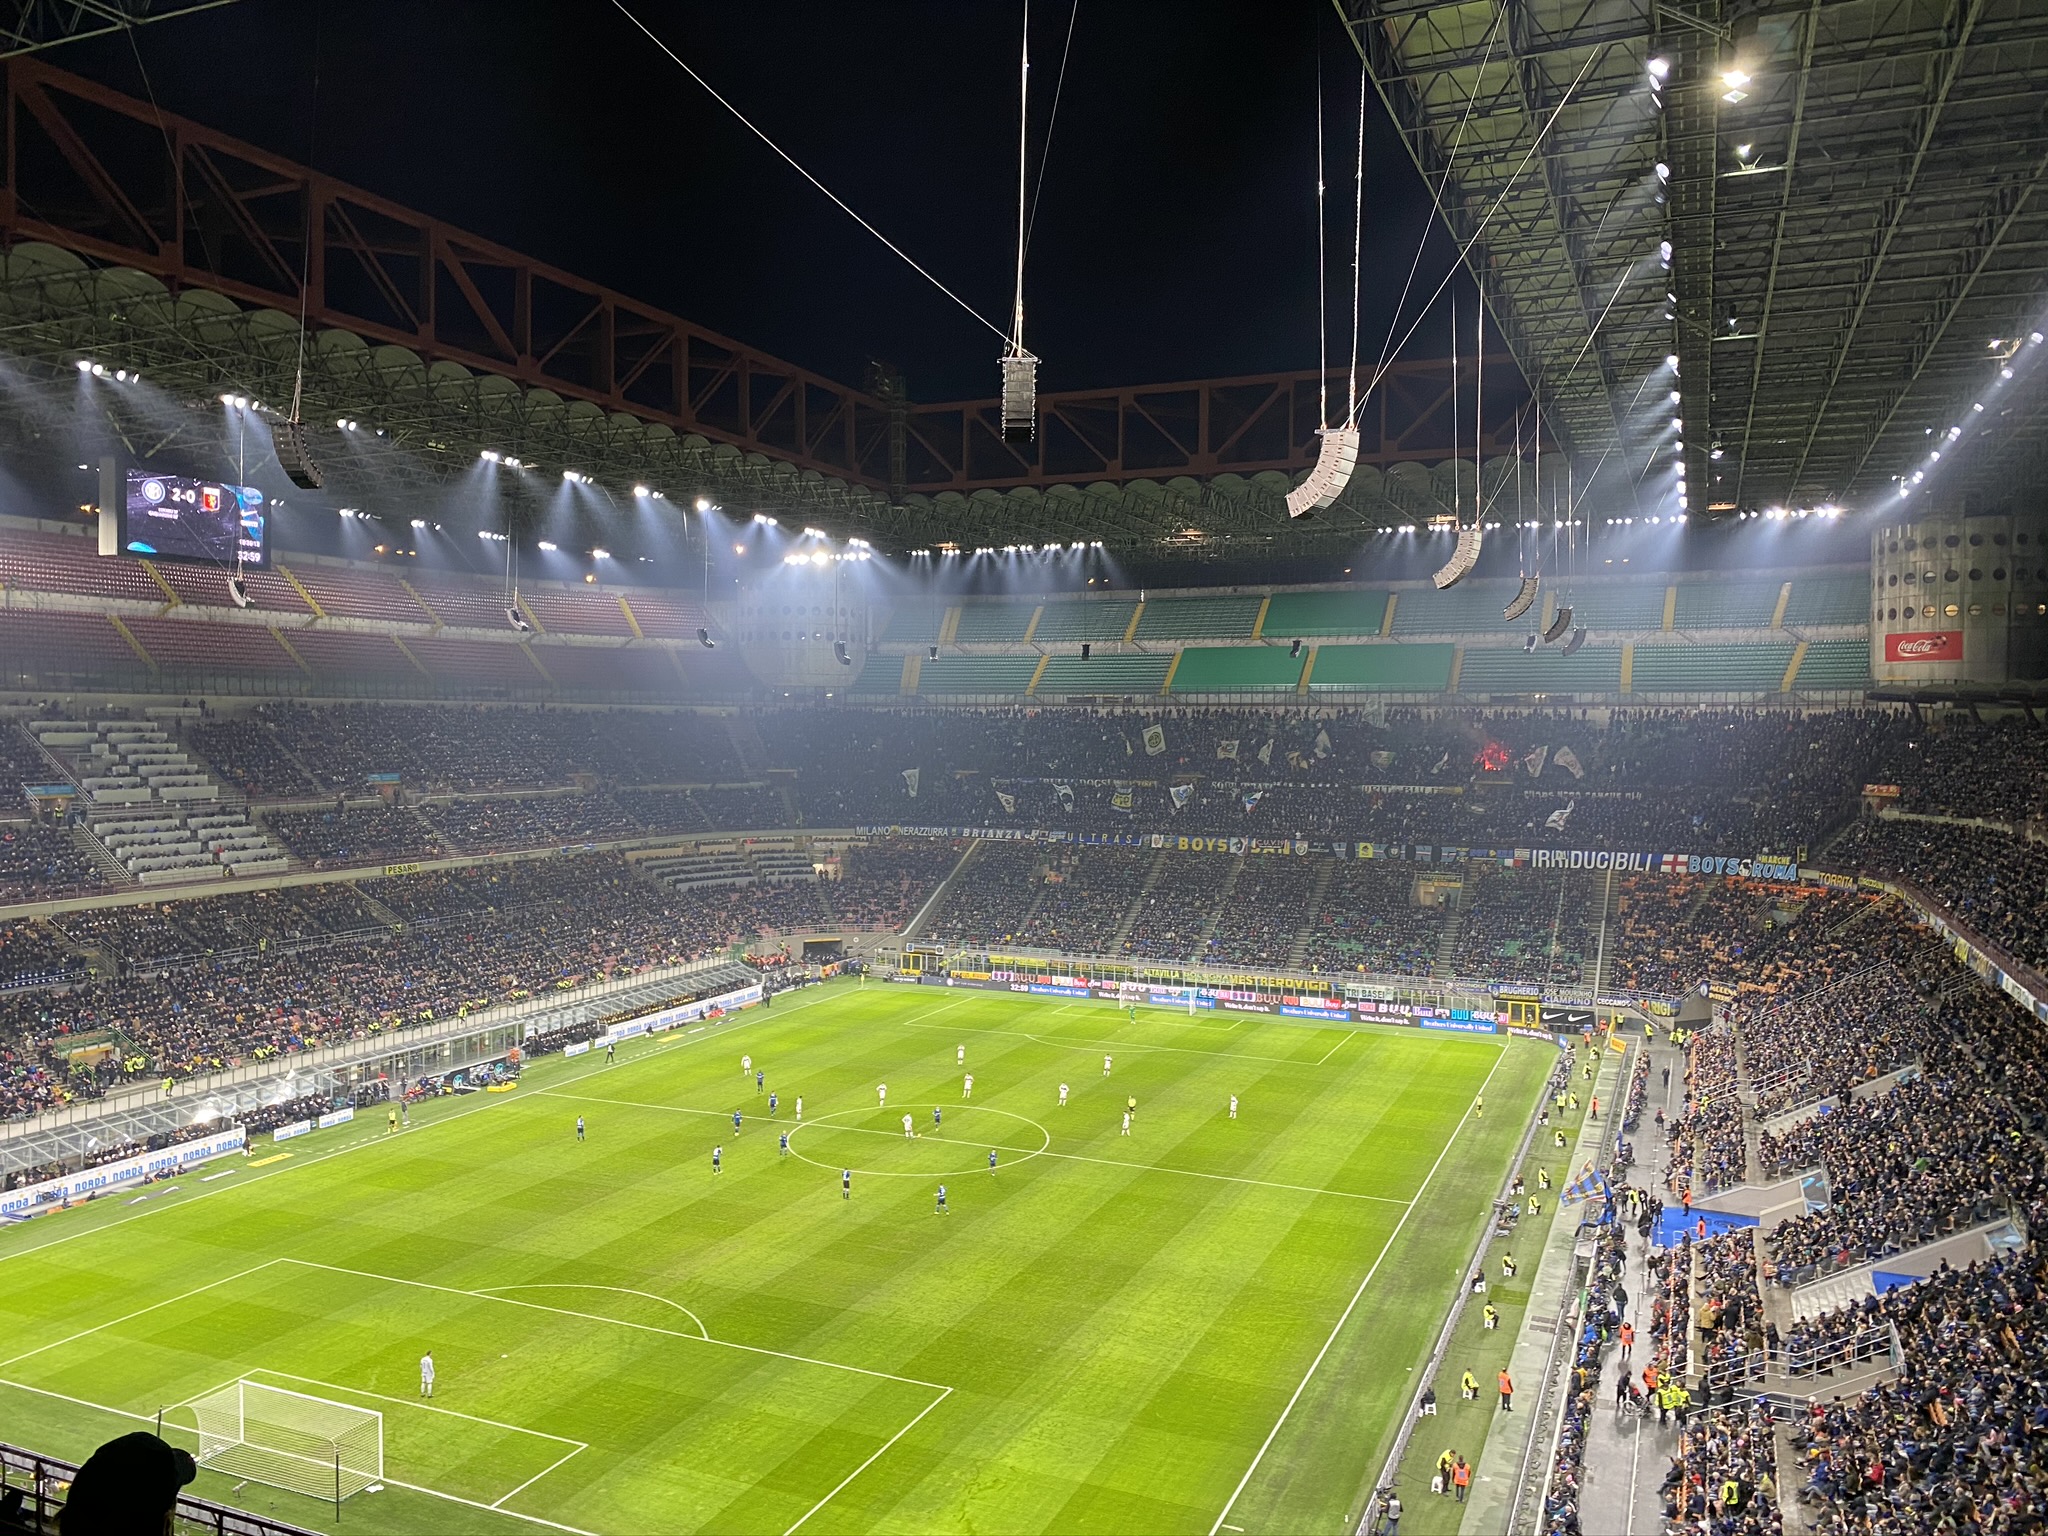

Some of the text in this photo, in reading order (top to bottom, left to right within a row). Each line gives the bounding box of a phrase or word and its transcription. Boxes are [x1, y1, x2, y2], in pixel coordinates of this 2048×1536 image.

[171, 488, 195, 503] 2-0
[856, 826, 948, 836] MILANO NERAZZURRA
[962, 828, 1021, 839] BRIANZA
[1067, 832, 1132, 844] ULTRAS
[1178, 837, 1228, 852] BOYS
[387, 863, 418, 874] PESARO
[1688, 855, 1797, 881] BOYS ROMA
[1819, 872, 1853, 889] TORRITA
[1143, 968, 1180, 978] ALTAVILLA
[1500, 985, 1539, 996] BRUGHERIO
[1544, 995, 1591, 1006] CIAMPINO
[1452, 1010, 1469, 1020] BUU
